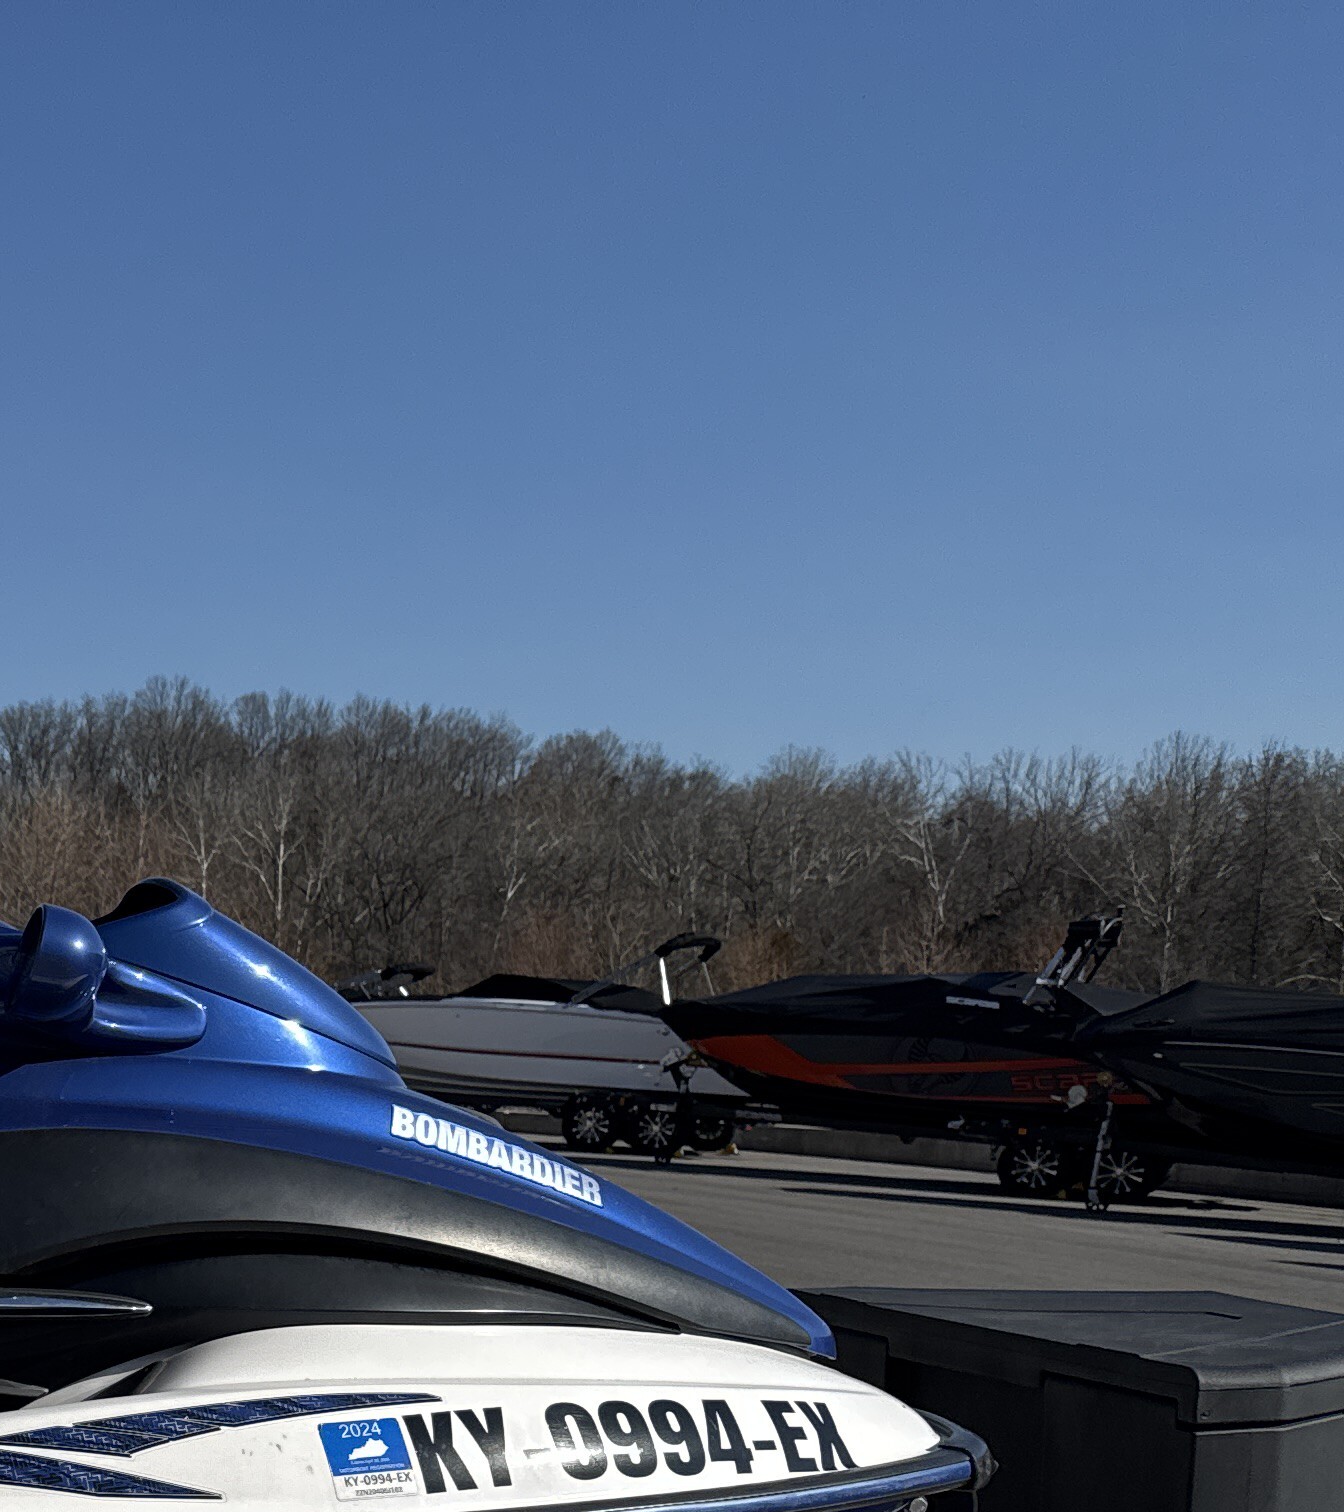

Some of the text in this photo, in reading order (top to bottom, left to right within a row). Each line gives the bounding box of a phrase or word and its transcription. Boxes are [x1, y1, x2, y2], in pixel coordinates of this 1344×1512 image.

[391, 1103, 604, 1208] BOMBARDIER
[338, 1421, 382, 1439] 2024
[401, 1398, 859, 1497] KY-0994-EX
[343, 1471, 413, 1488] KY-0994-EX
